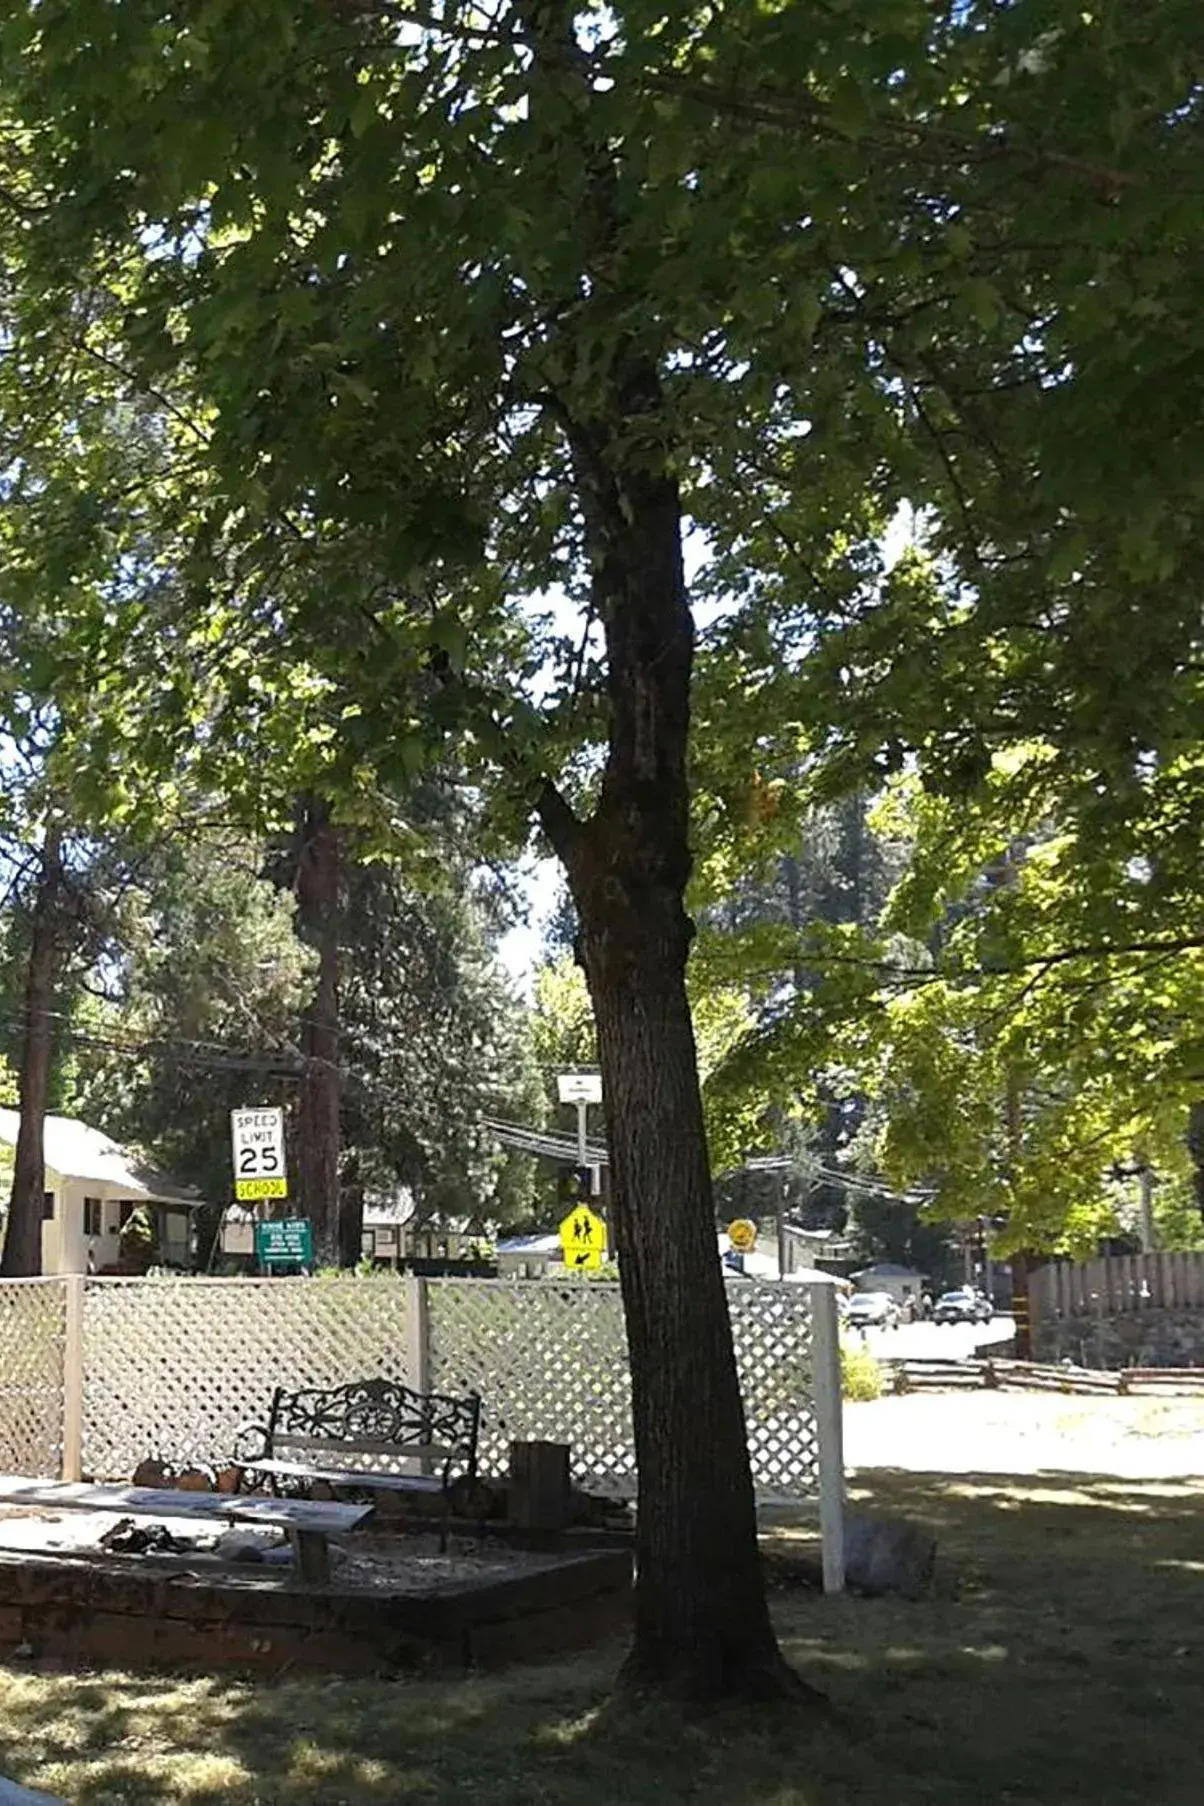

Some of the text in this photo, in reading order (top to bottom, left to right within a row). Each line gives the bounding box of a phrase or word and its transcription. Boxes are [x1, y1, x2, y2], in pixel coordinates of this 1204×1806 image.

[236, 1114, 278, 1129] SPEED
[240, 1130, 273, 1145] LIMIT
[240, 1146, 279, 1173] 25
[238, 1181, 284, 1197] SCHOOL
